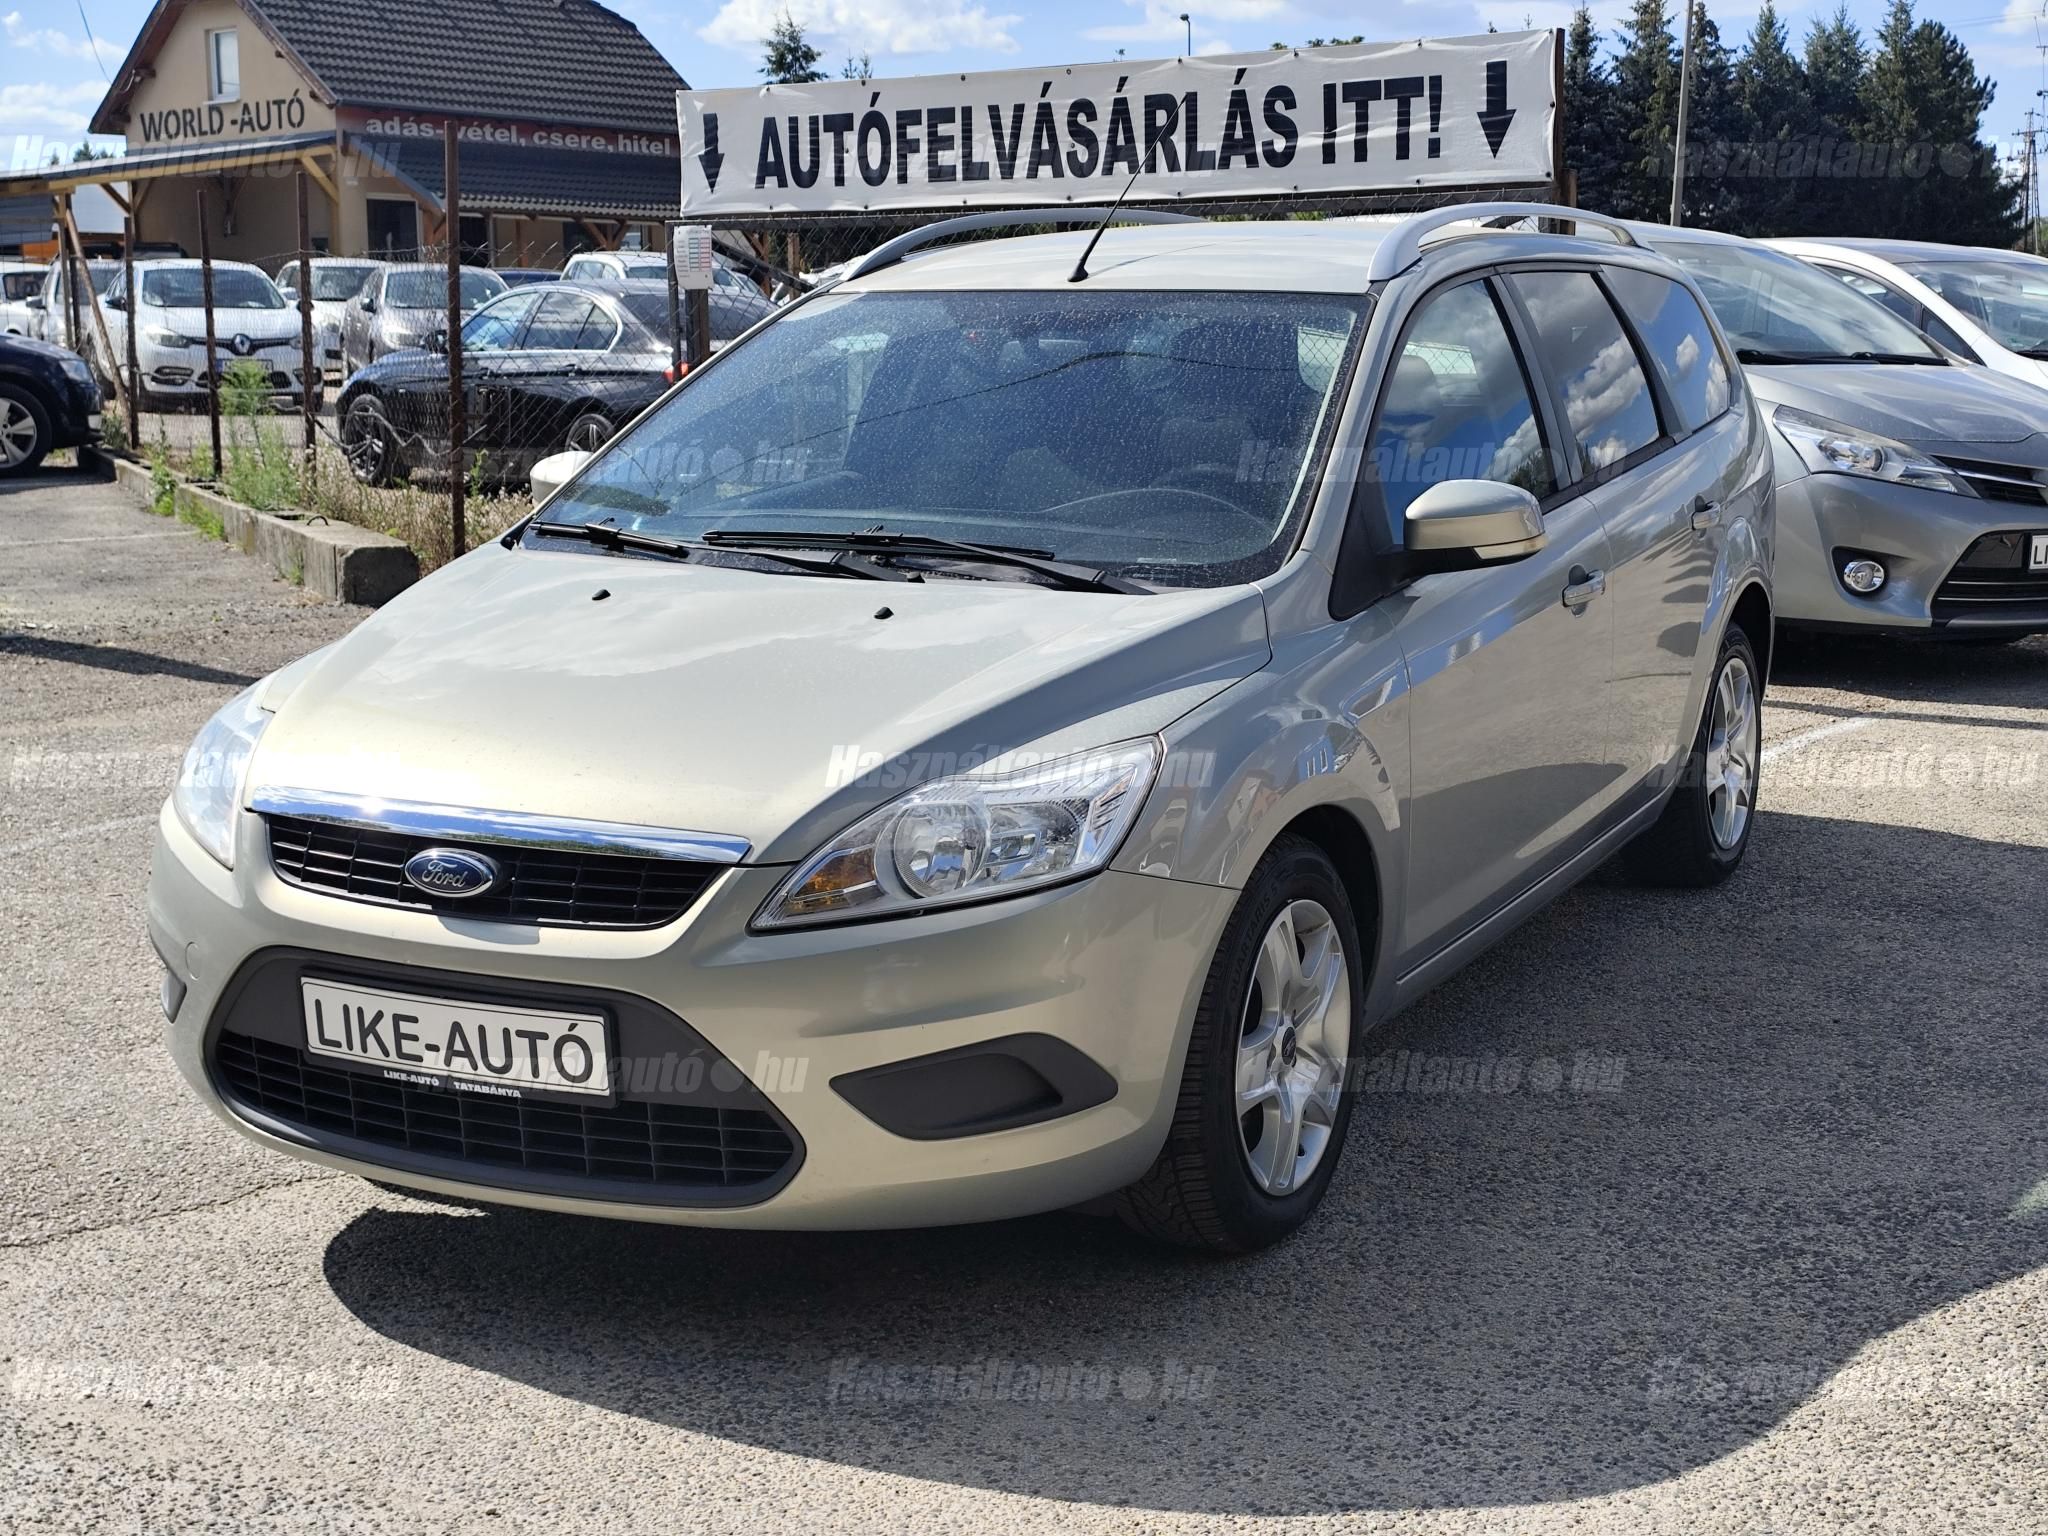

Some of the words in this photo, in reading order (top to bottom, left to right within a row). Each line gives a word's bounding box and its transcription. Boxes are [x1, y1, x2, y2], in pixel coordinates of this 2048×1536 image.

[754, 67, 1298, 189] AUTÓFELVÁSÁRLÁS
[1322, 75, 1442, 164] ITT!
[618, 133, 670, 156] hitel
[421, 859, 469, 888] Ford
[314, 998, 594, 1084] LIKE-AUTÓ
[383, 1069, 440, 1087] LIKE-AUTÓ
[453, 1081, 522, 1098] TATABÁNYA
